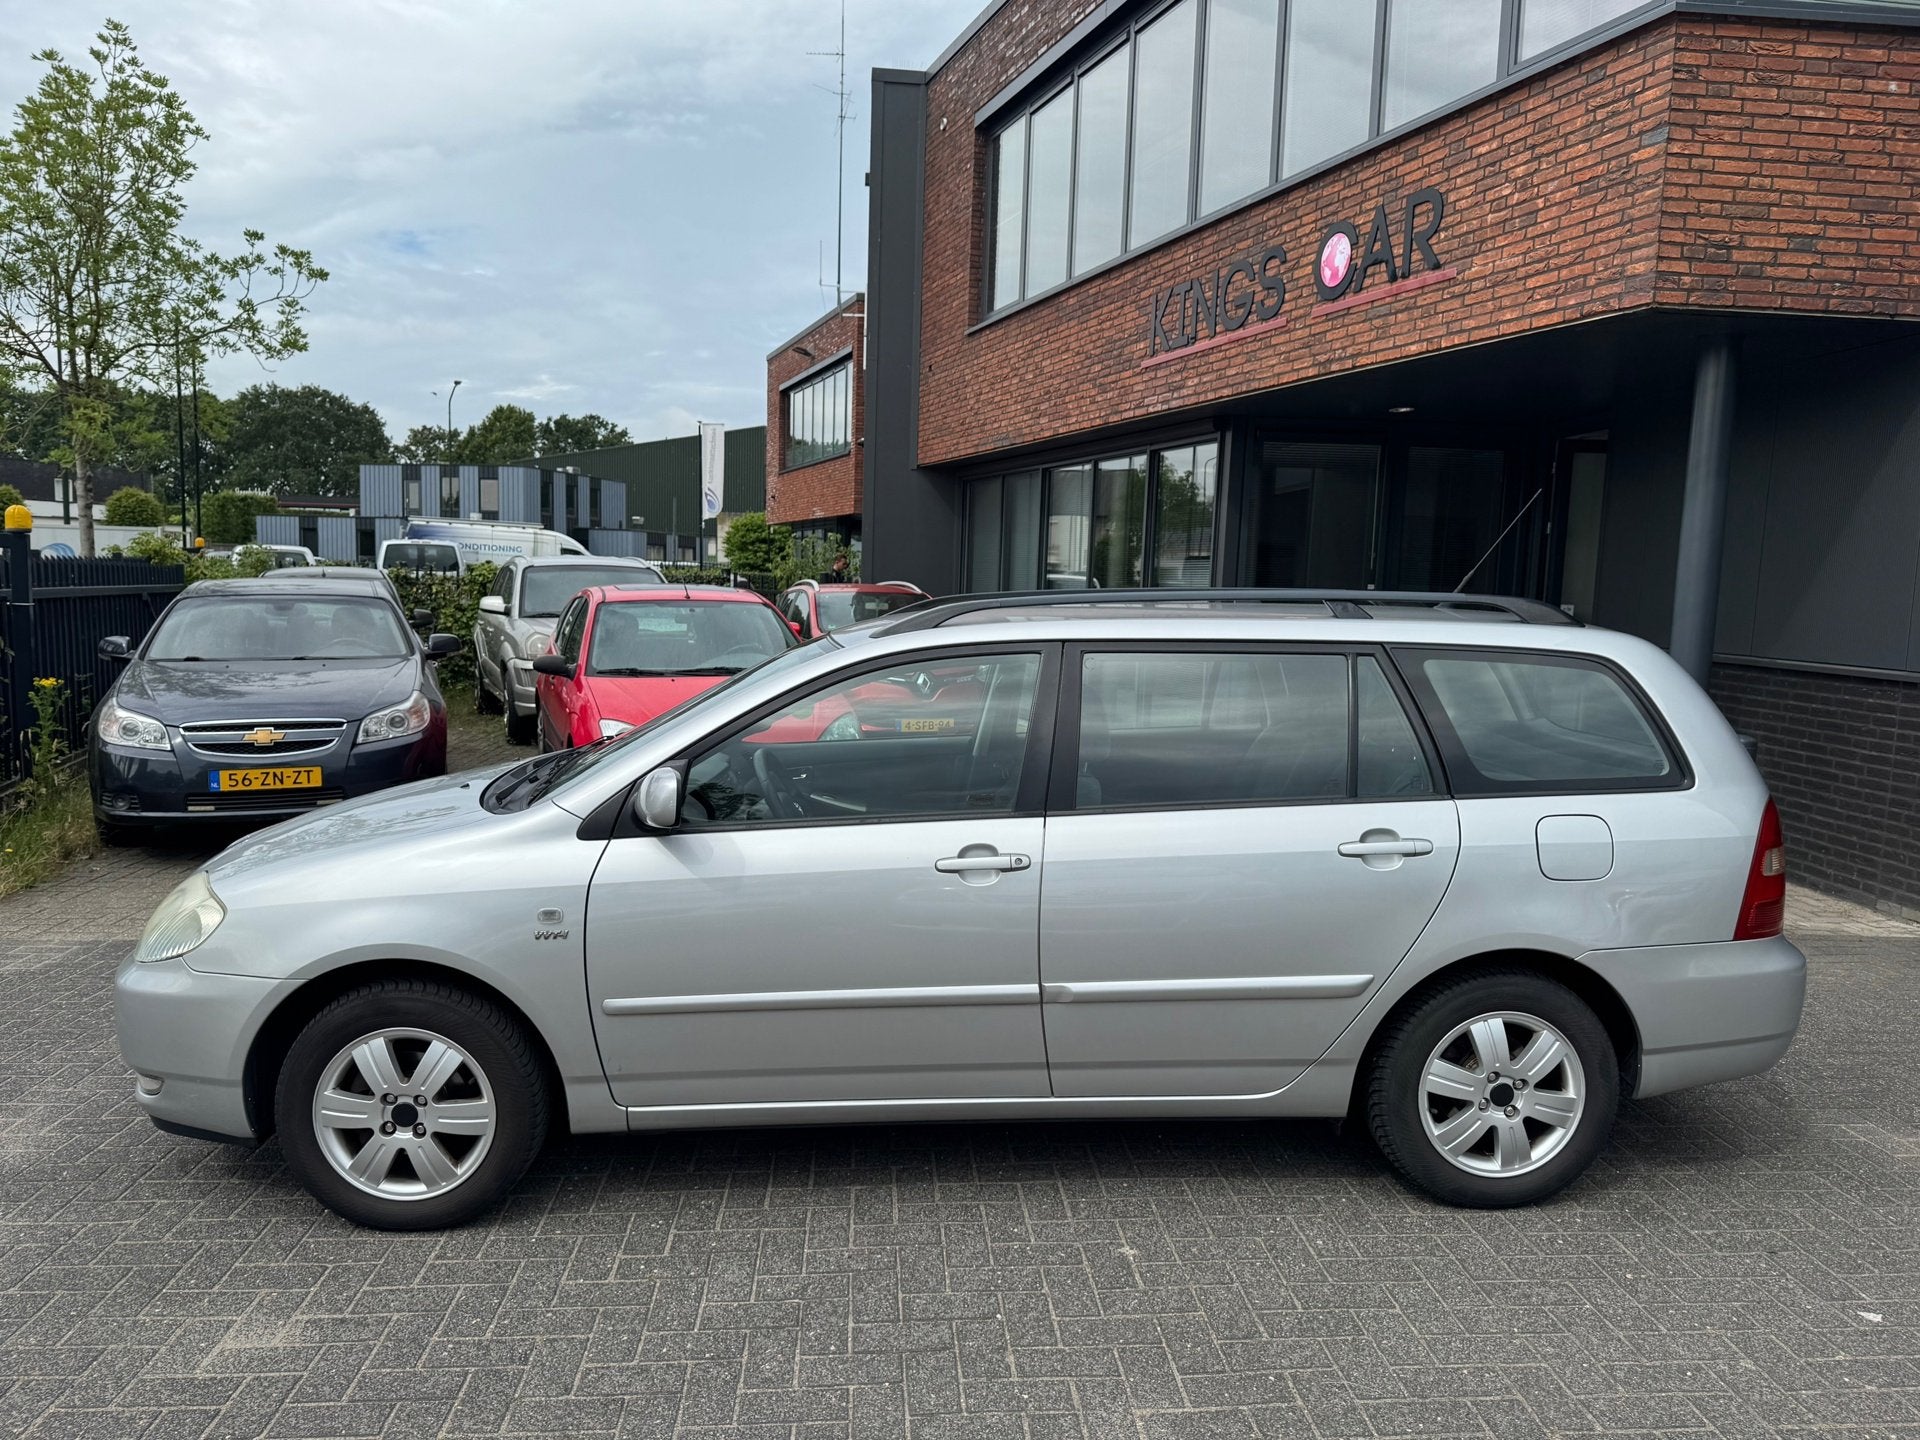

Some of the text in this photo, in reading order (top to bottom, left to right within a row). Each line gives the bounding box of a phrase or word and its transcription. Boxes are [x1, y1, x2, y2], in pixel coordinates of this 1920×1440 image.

[1149, 187, 1444, 355] KINGS CAR
[458, 542, 523, 553] ONDITIONING
[228, 769, 314, 788] 56-ZN-ZT
